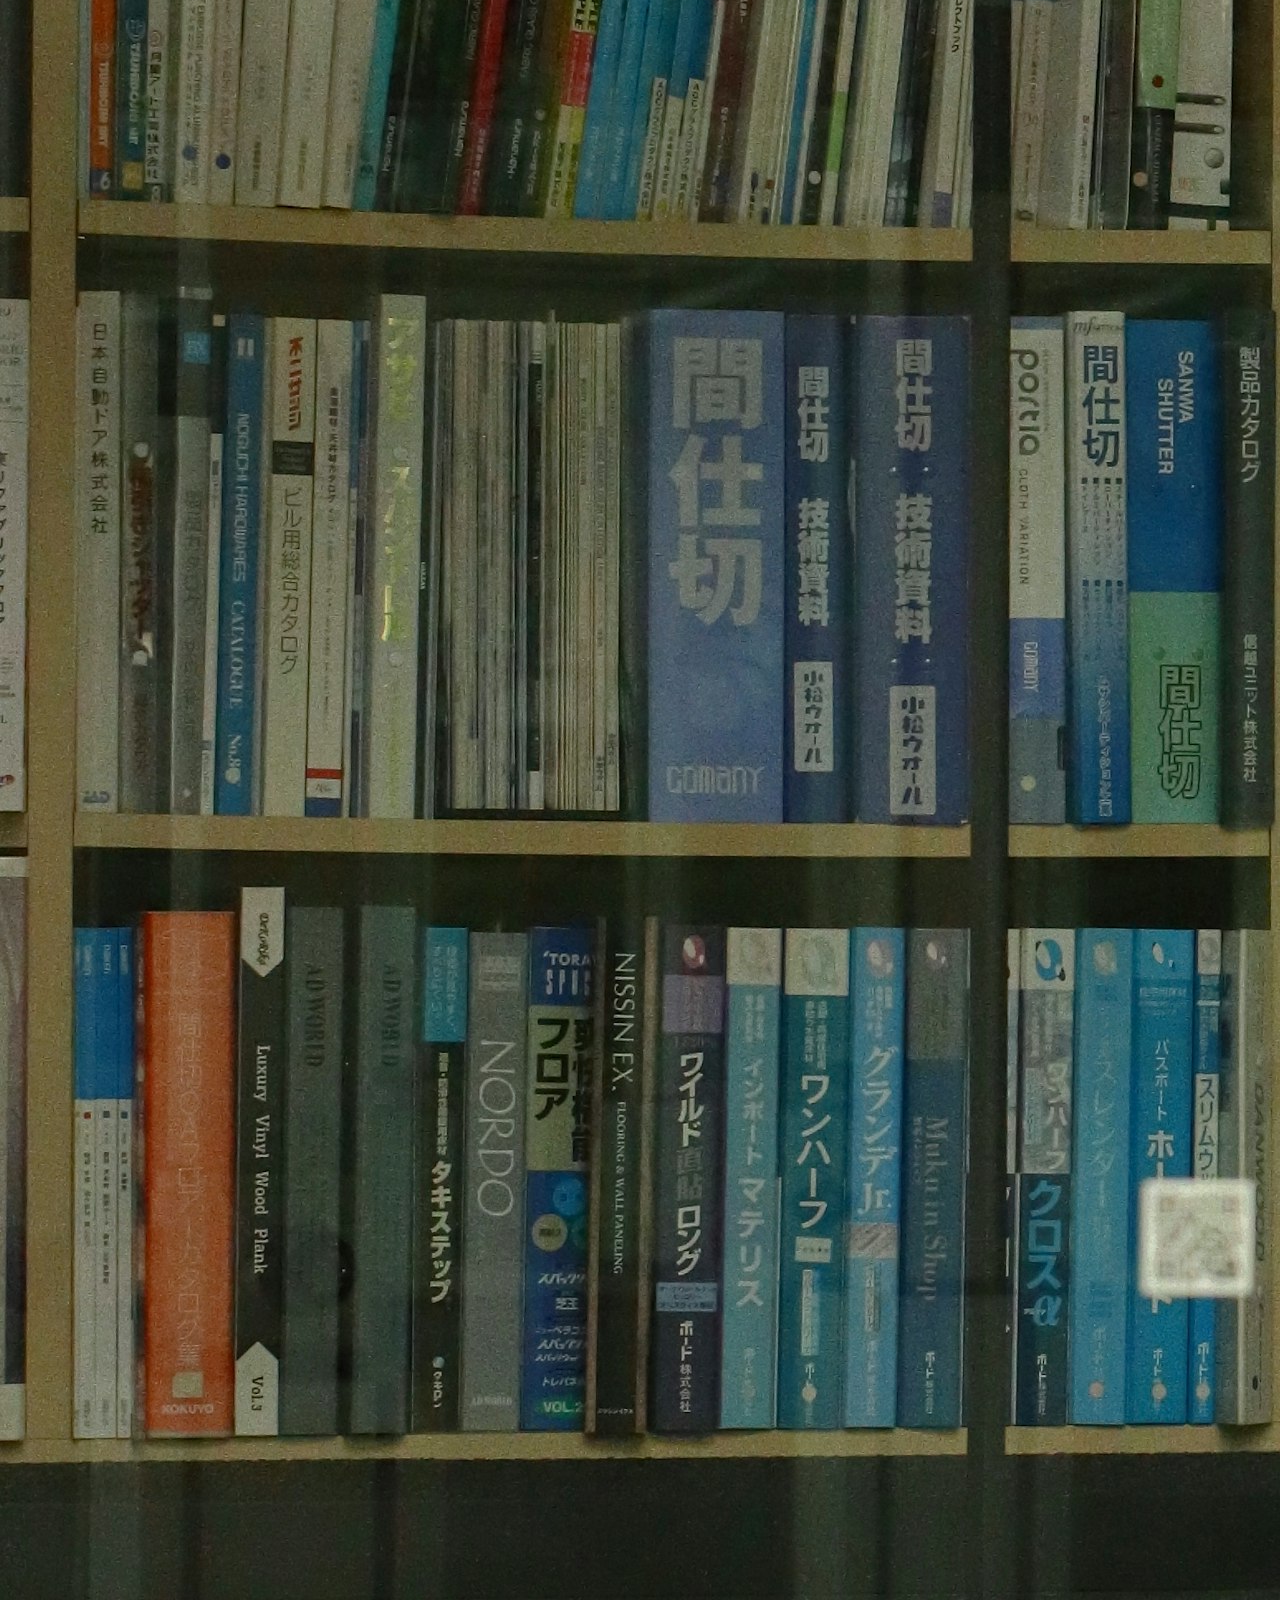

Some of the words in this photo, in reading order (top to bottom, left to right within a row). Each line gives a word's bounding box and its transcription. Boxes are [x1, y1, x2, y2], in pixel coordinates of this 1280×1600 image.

[90, 322, 109, 536] 日本自動ドア株式会社
[797, 366, 829, 463] 間仕切
[895, 338, 931, 453] 間仕切
[1010, 348, 1040, 458] portia
[1080, 343, 1121, 468] 間仕切
[1156, 377, 1175, 476] SHUTTER
[1177, 350, 1194, 423] SANWA
[1238, 345, 1261, 484] 製品カタログ
[234, 413, 250, 482] NOGUCHI
[668, 337, 765, 628] 間仕切
[1018, 469, 1030, 509] CLOTH
[279, 486, 303, 676] ビル用総合カタログ
[797, 497, 829, 627] 技術資料
[895, 493, 931, 643] 技術資料
[1017, 514, 1030, 587] VARIATION
[230, 600, 246, 709] CATALOGUE
[1158, 663, 1203, 800] 間仕切
[613, 951, 637, 1044] NISSIN
[253, 1044, 270, 1101] Luxury
[533, 1016, 570, 1121] フロア
[611, 1052, 636, 1090] EX.
[677, 1051, 703, 1148] ワイルド
[861, 1047, 898, 1179] グランデ
[253, 1109, 270, 1162] Vinyl
[477, 1039, 515, 1217] NORDO
[798, 1073, 831, 1231] ワンハーフ
[253, 1167, 270, 1215] Wood
[429, 1160, 451, 1303] タキステップ
[675, 1204, 700, 1276] ロング
[252, 1223, 269, 1275] Plank
